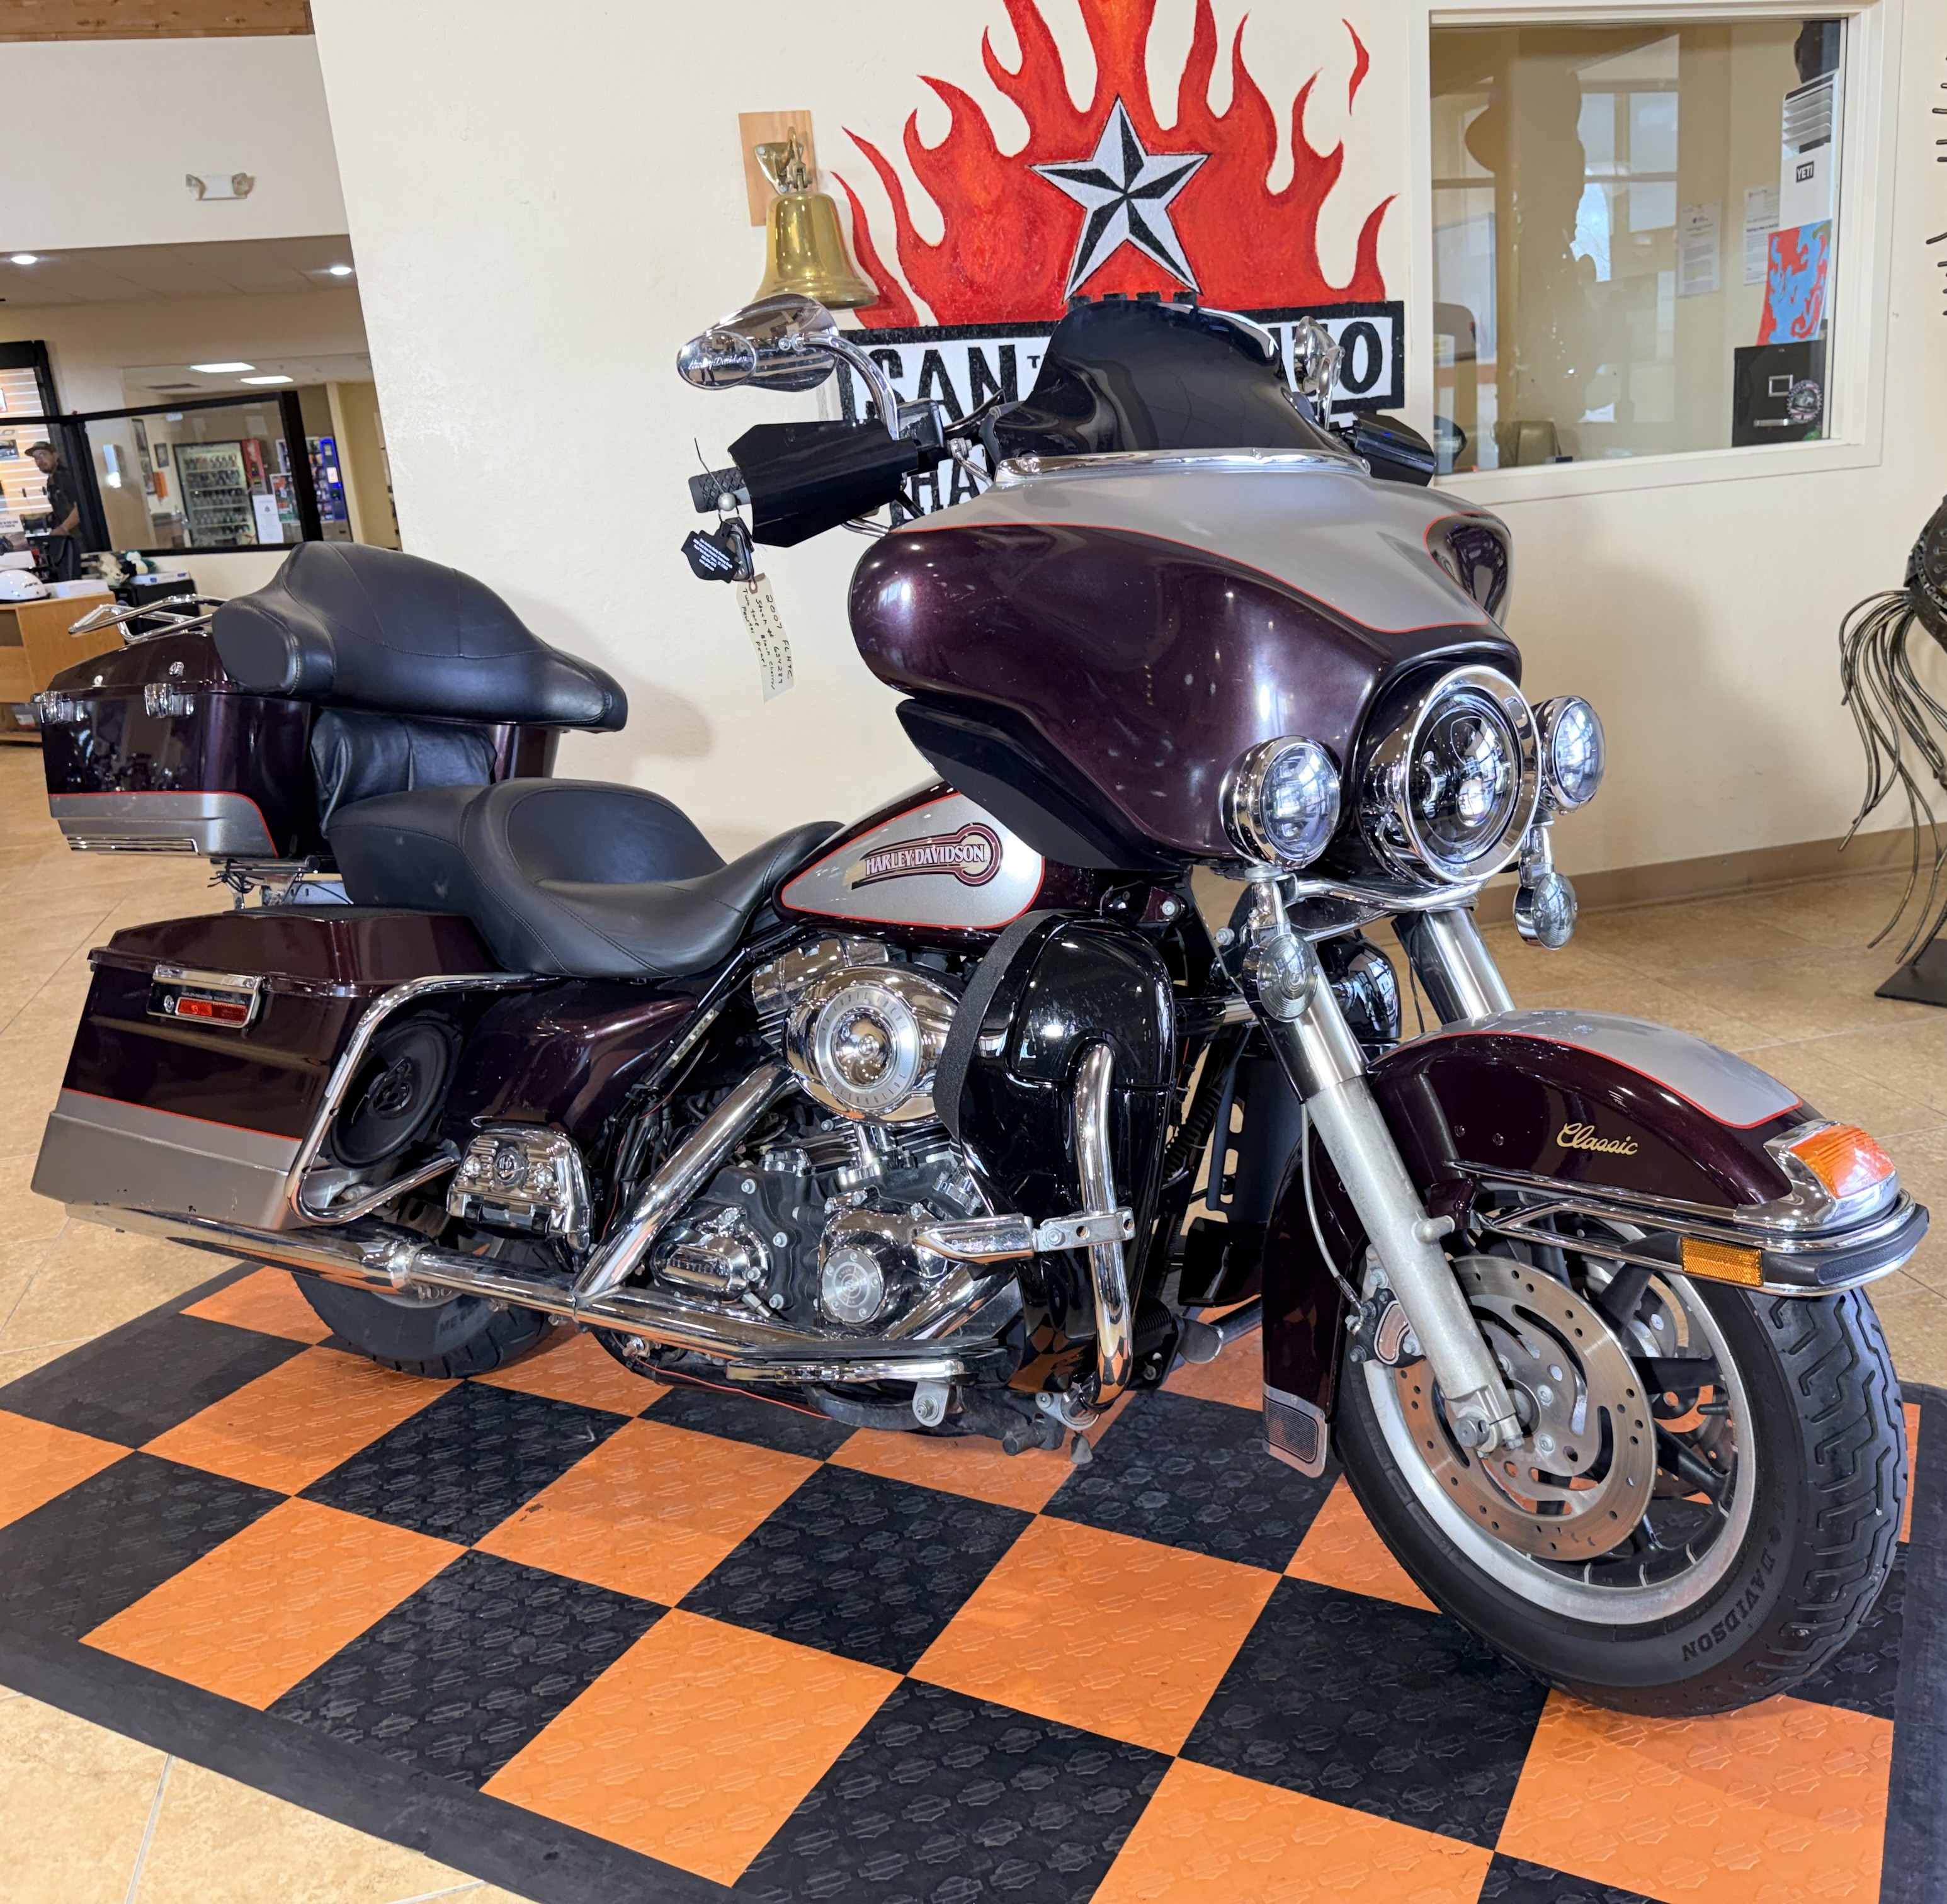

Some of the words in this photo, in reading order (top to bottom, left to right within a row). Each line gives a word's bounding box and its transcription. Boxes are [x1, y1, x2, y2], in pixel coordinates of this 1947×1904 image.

[1797, 164, 1813, 181] YETI
[756, 598, 768, 625] Stock
[766, 594, 783, 629] 2007
[1556, 1123, 1638, 1155] Classic
[1682, 1546, 1776, 1662] DAVIDSON
